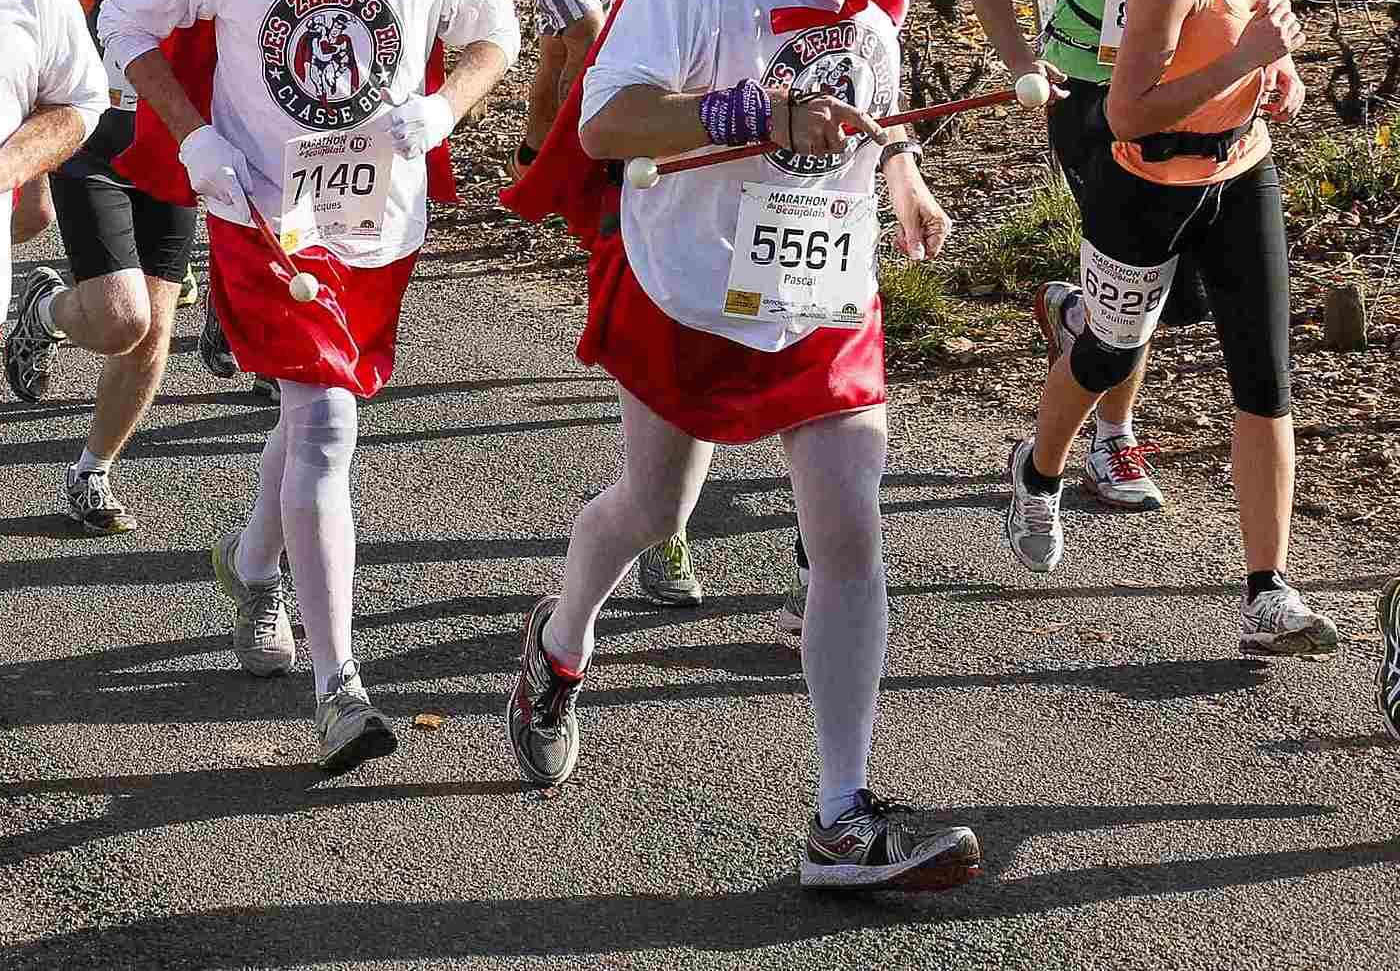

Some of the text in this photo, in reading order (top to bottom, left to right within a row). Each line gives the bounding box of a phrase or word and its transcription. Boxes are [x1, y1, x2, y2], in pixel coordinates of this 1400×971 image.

[263, 15, 291, 66] LES
[793, 25, 877, 66] ZERO'S
[278, 85, 354, 125] CLASSE
[299, 134, 346, 149] MARATHON
[292, 163, 376, 205] 7140
[768, 192, 828, 206] MARATHON
[775, 203, 826, 218] Beaujolais
[750, 224, 852, 272] 5561
[783, 274, 817, 286] Pascal
[1085, 267, 1164, 316] 6228
[1100, 309, 1136, 326] Pauline
